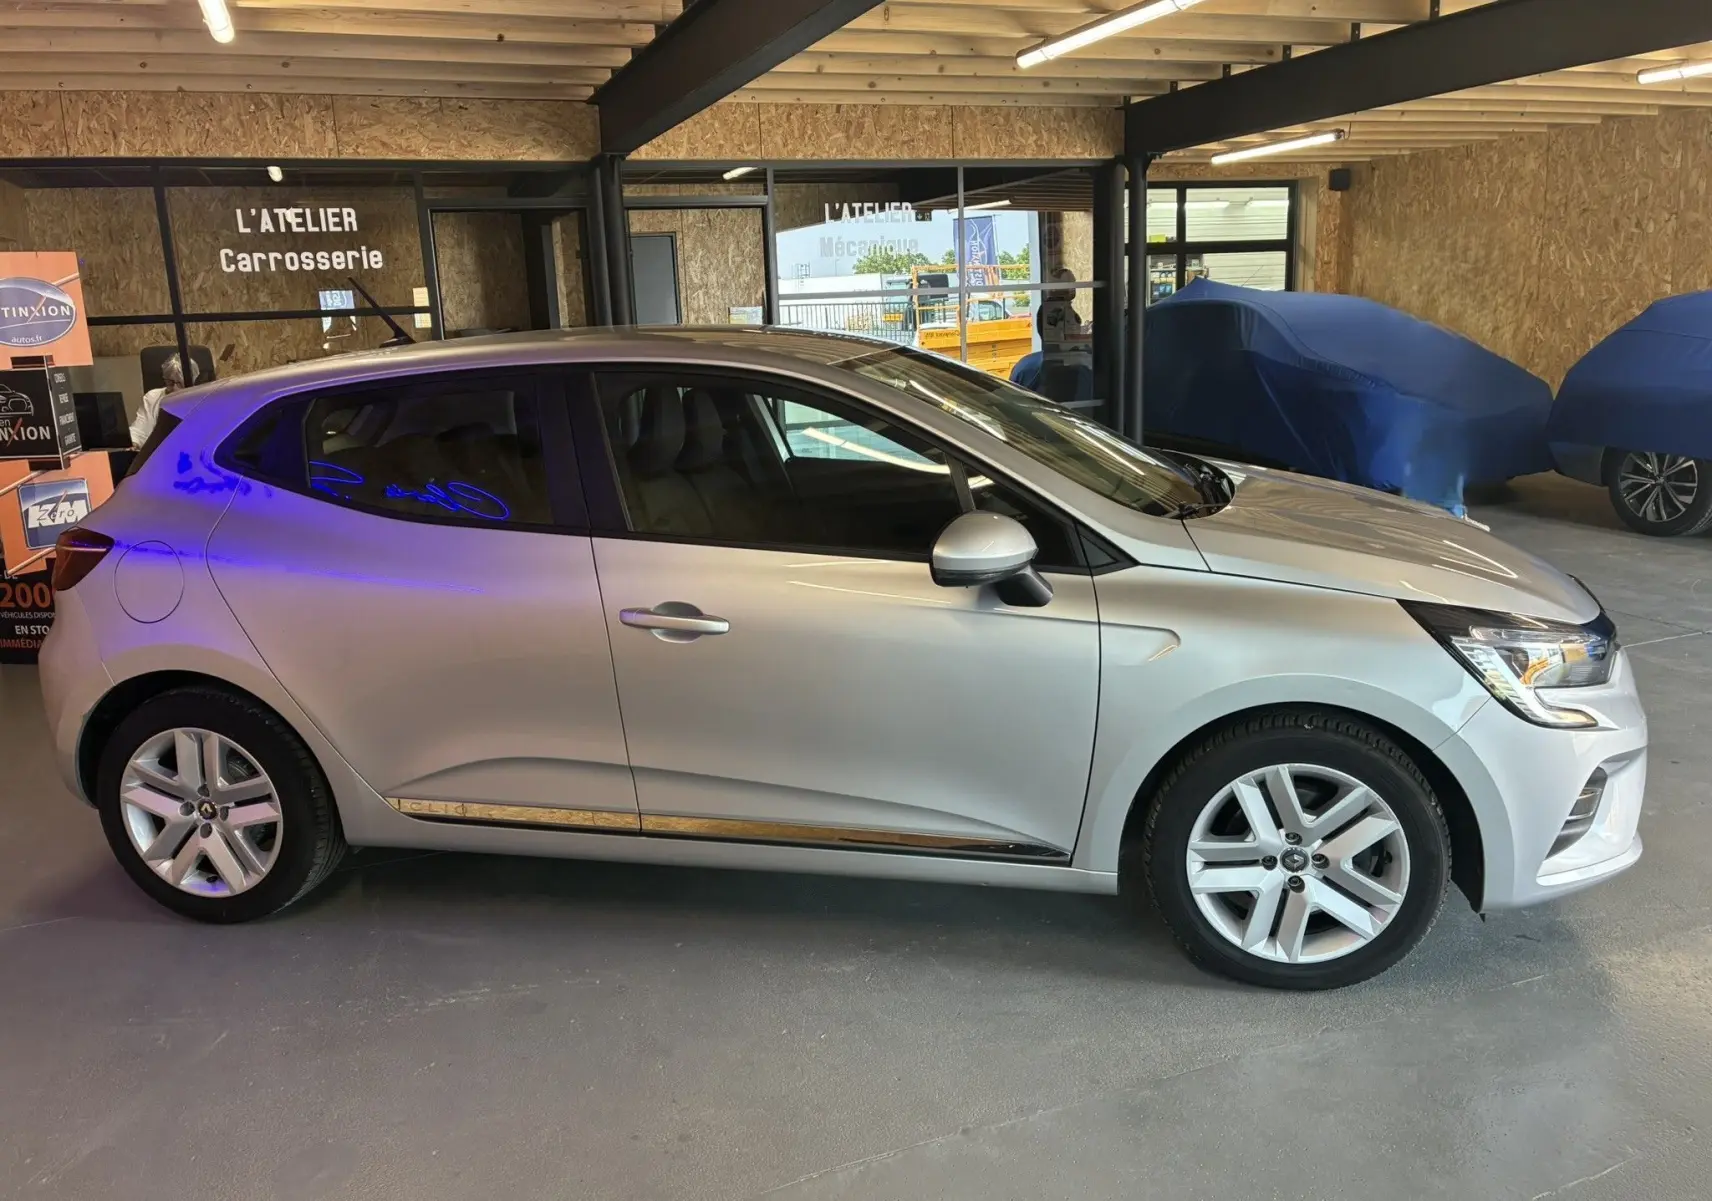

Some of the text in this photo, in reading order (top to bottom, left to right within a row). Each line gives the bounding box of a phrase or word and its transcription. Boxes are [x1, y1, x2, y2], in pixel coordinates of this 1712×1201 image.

[235, 207, 358, 233] L'ATELIER
[824, 202, 913, 224] L'ATELIER
[819, 236, 919, 260] Mécanique
[219, 246, 383, 273] Carrosserie
[1, 304, 71, 319] TINXION
[11, 334, 43, 344] autos.fr
[37, 508, 75, 521] Zero
[15, 625, 29, 635] EN
